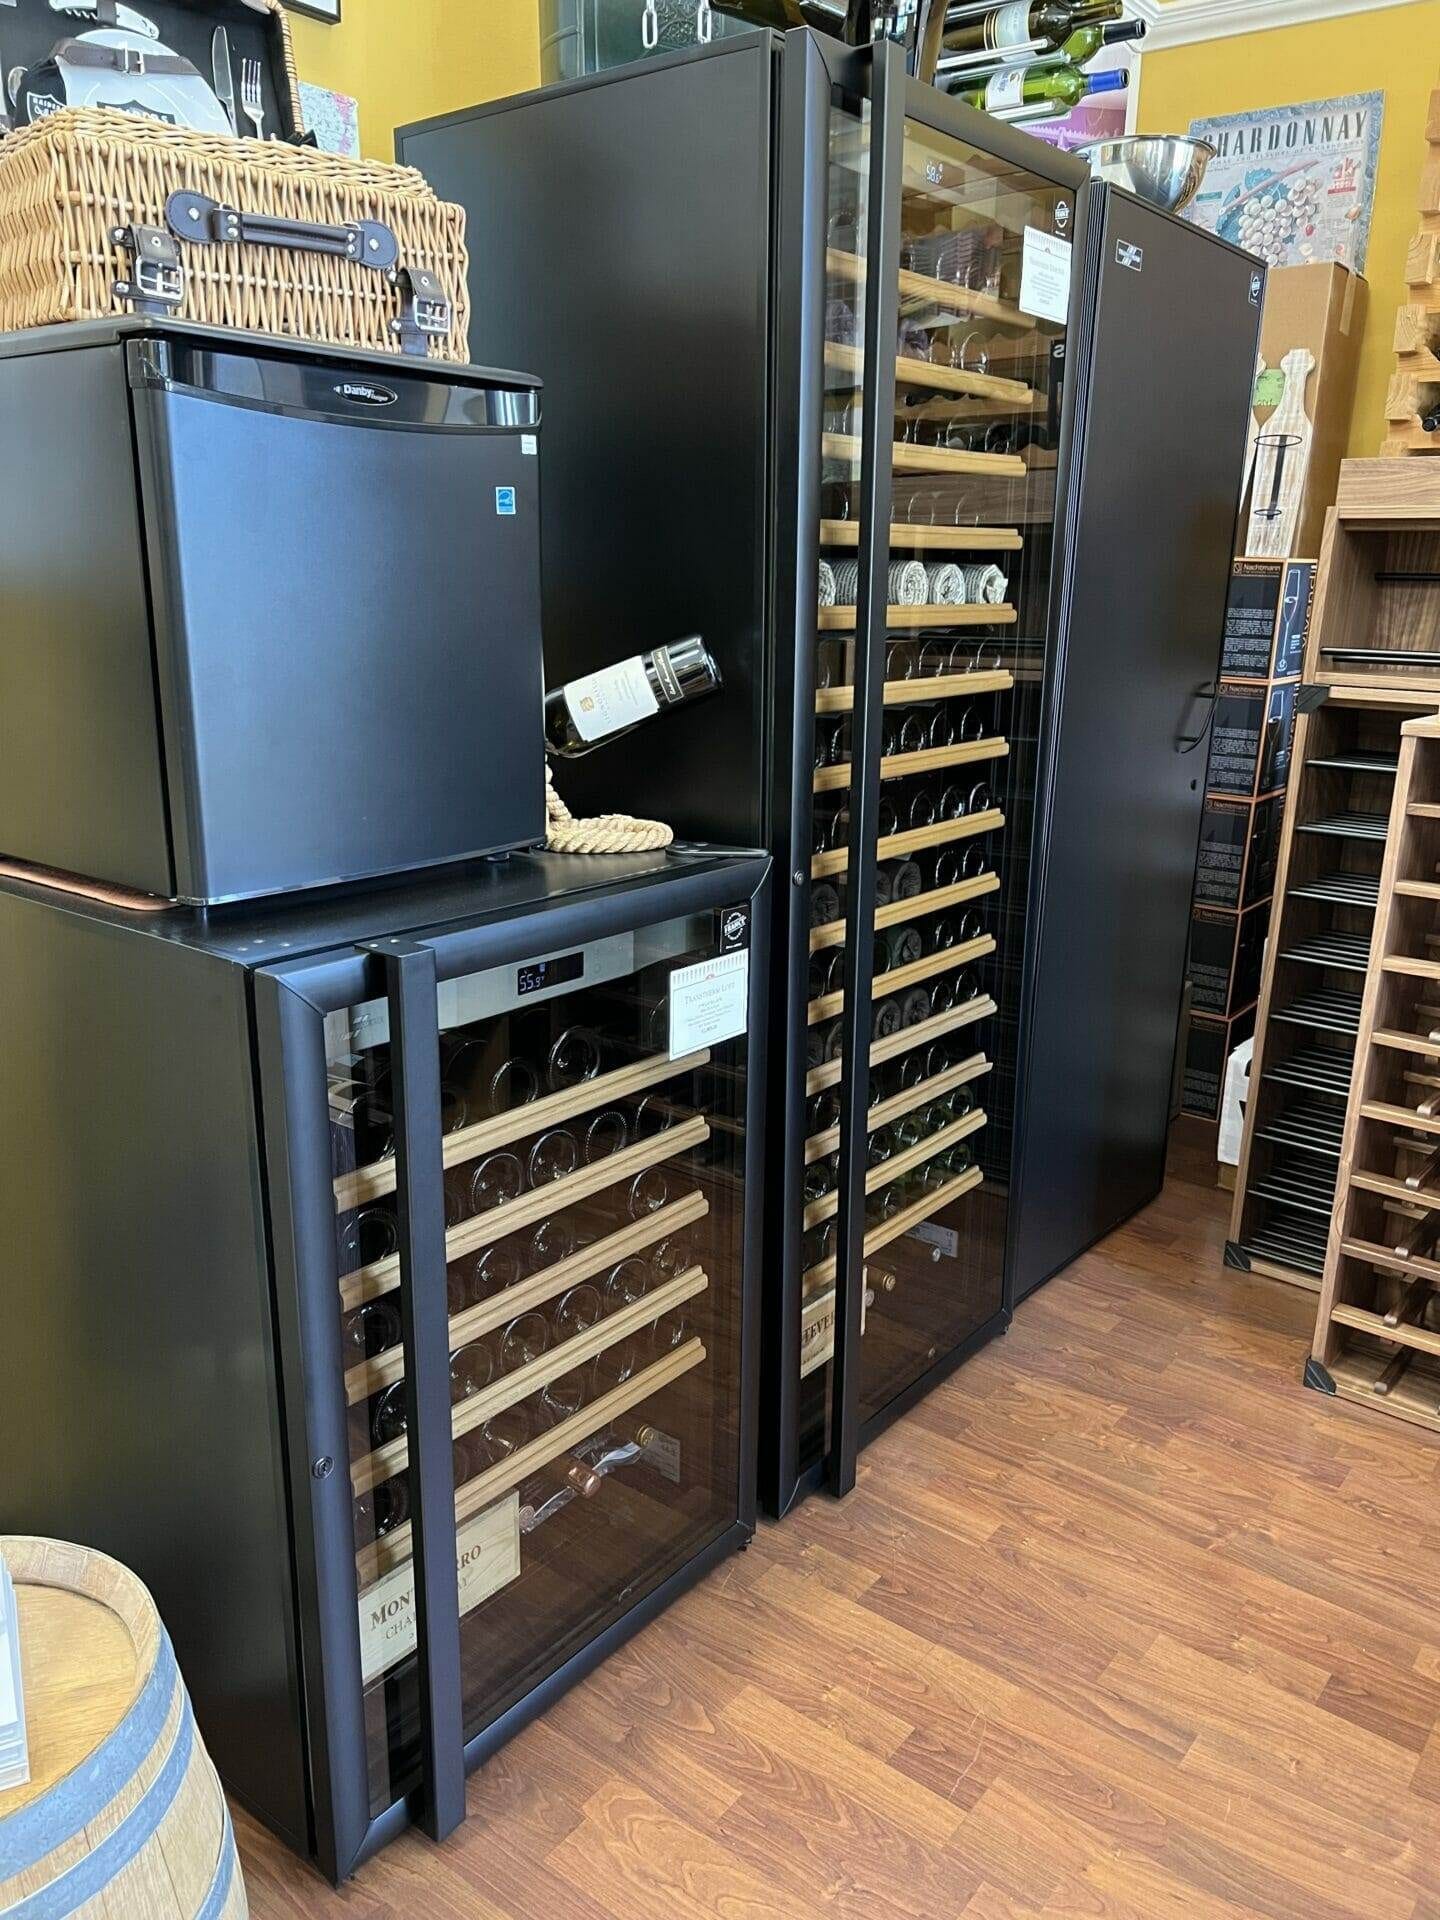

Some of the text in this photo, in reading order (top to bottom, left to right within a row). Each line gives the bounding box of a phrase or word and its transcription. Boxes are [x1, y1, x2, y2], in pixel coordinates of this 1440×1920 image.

[343, 384, 375, 399] Danby
[803, 1312, 834, 1344] TEVE
[371, 1589, 414, 1631] MON
[385, 1611, 416, 1641] CHA
